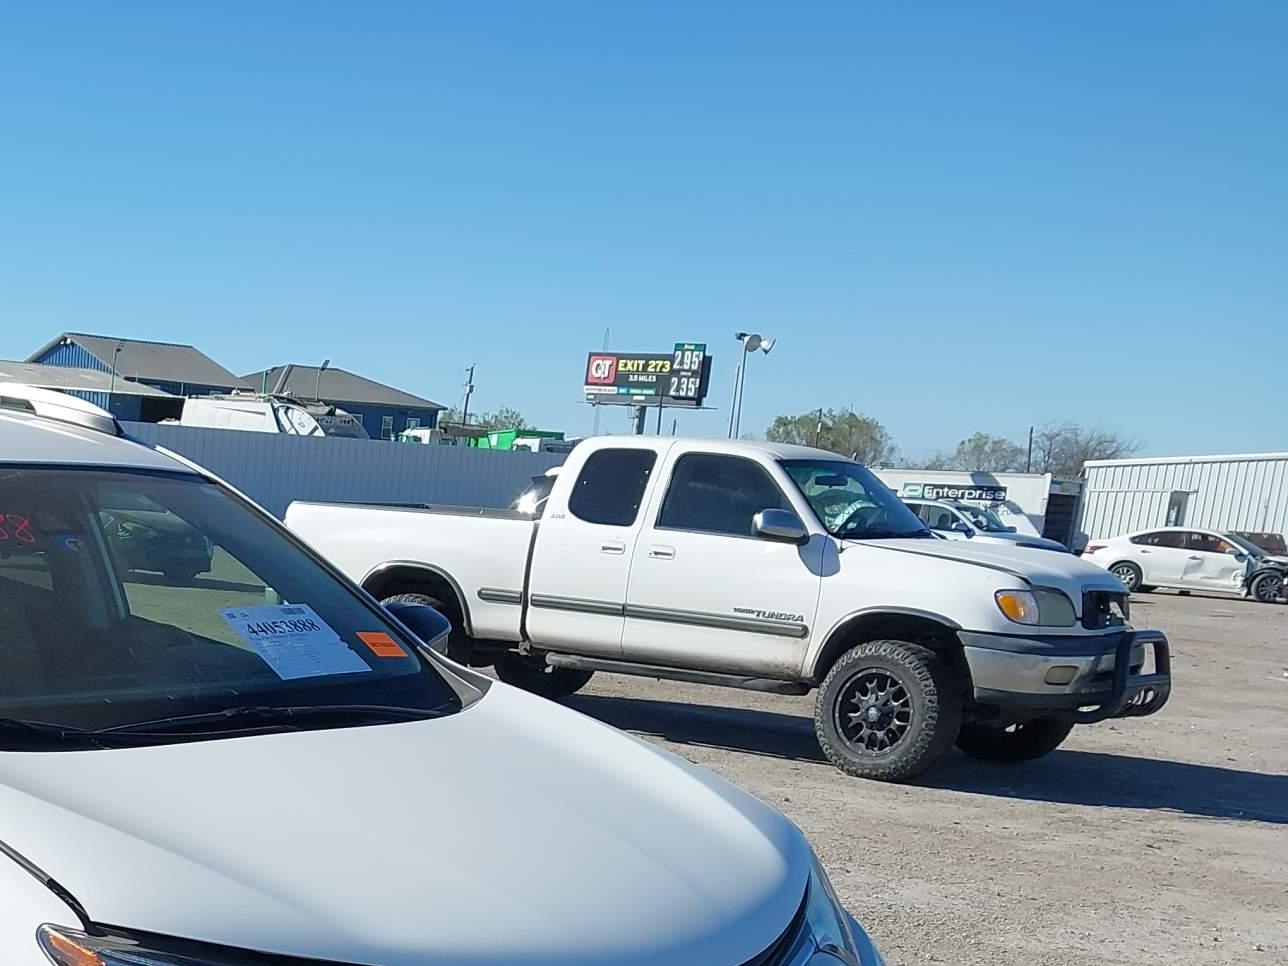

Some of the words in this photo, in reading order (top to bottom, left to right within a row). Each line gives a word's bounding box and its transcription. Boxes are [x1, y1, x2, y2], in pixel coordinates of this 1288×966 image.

[617, 359, 645, 372] EXIT
[647, 360, 671, 373] 273
[924, 485, 1006, 501] Enterprise
[756, 610, 804, 622] TUNDRA
[247, 618, 321, 636] 44053888
